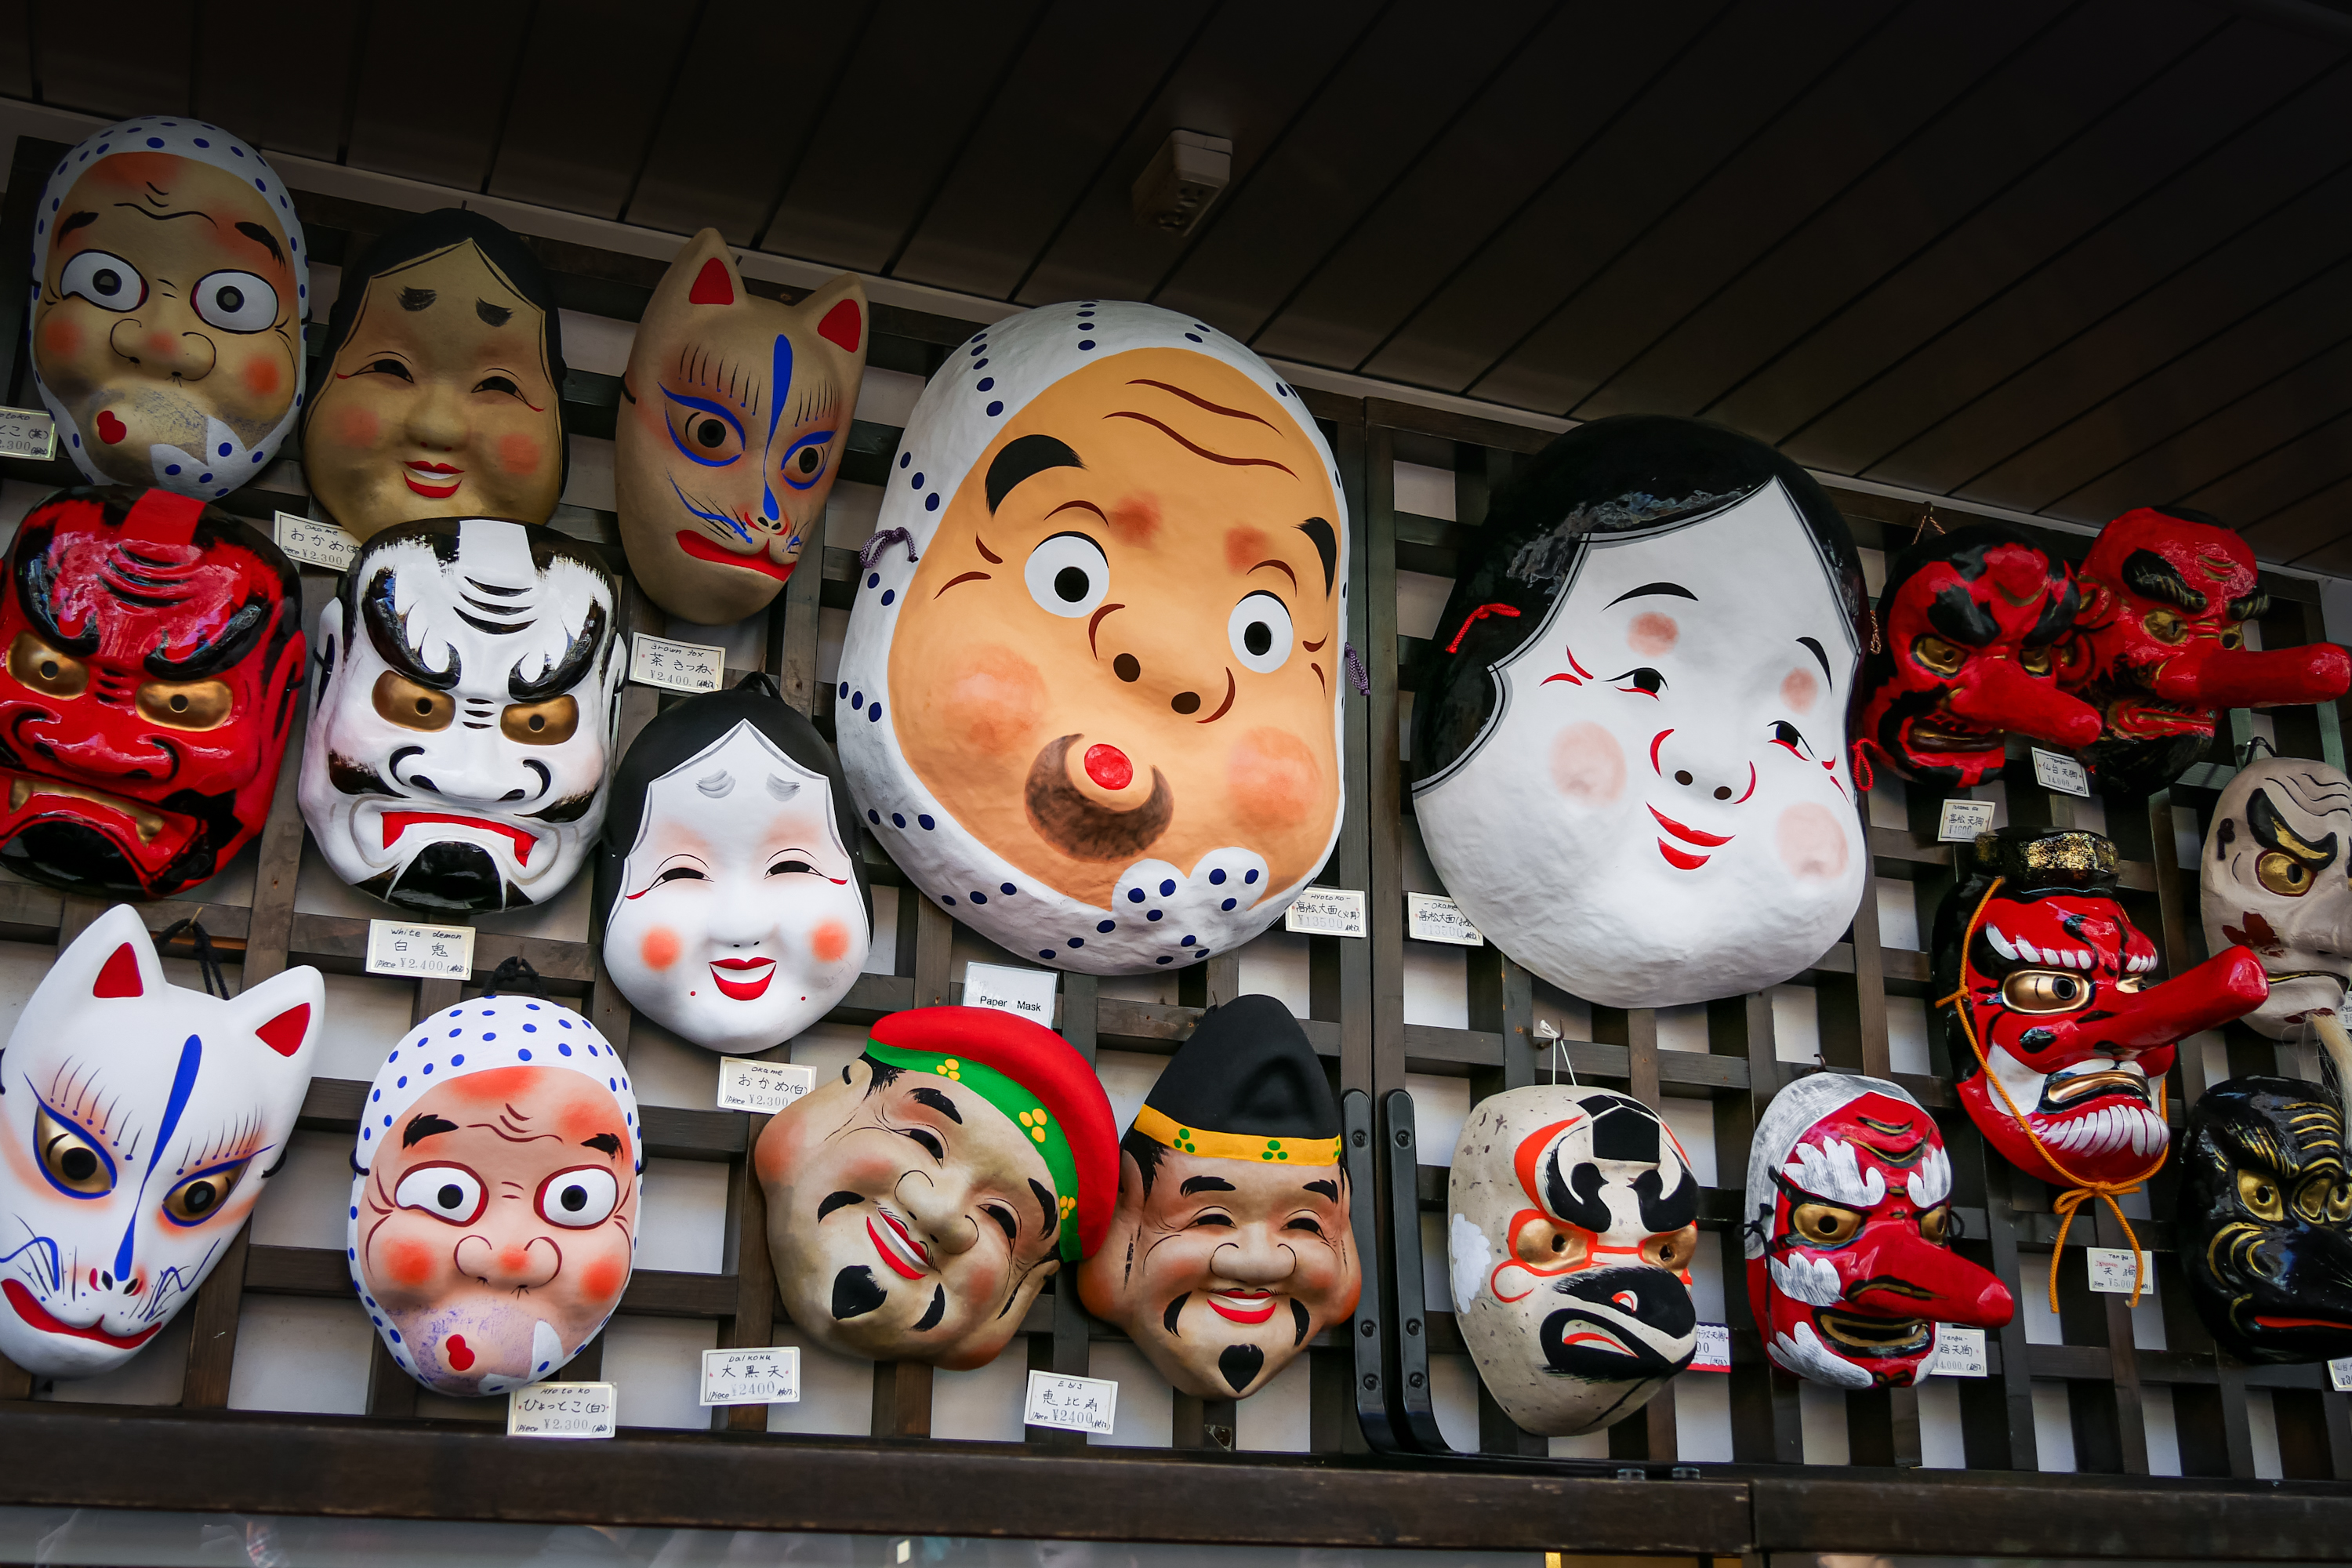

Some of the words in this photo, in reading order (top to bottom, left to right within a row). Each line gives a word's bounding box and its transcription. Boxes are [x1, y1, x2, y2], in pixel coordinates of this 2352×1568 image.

[432, 931, 462, 939] demon
[980, 996, 1007, 1007] Paper
[1017, 1000, 1041, 1011] Mask
